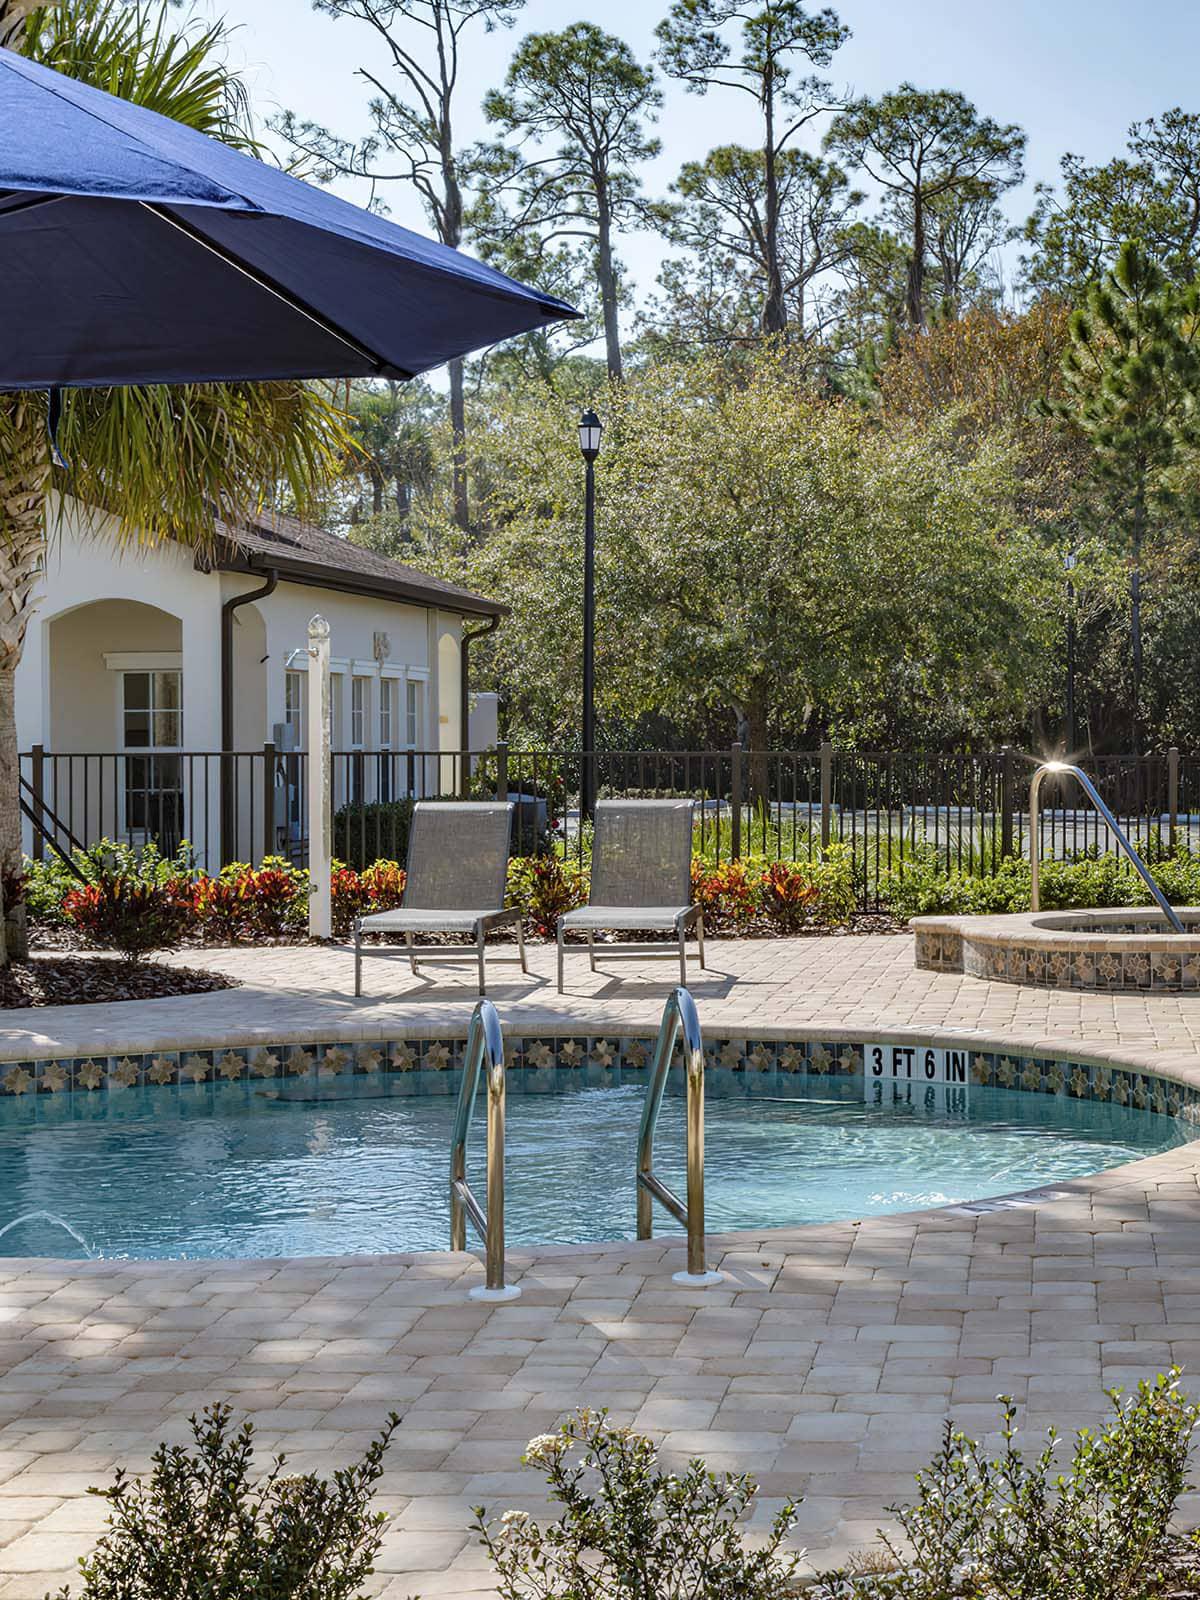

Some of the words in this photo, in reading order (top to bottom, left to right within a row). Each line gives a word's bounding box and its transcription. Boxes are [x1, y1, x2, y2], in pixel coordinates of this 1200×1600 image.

[872, 1047, 883, 1076] 3
[892, 1047, 915, 1078] FT
[925, 1049, 936, 1079] 6
[945, 1051, 966, 1083] IN
